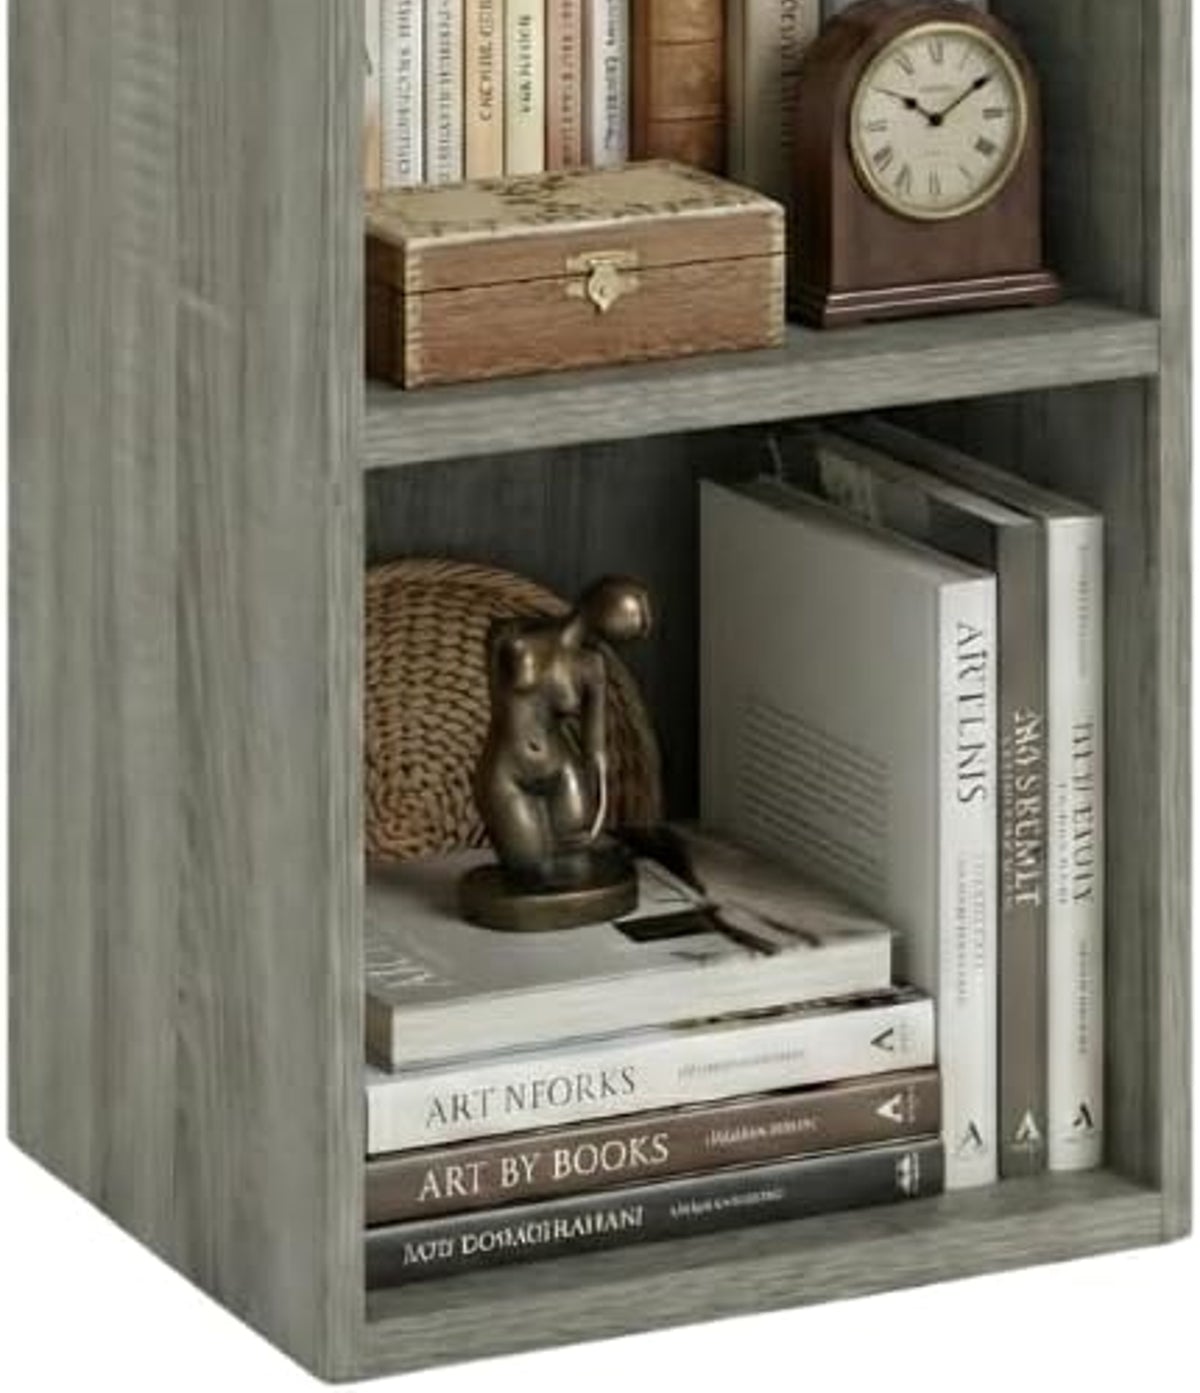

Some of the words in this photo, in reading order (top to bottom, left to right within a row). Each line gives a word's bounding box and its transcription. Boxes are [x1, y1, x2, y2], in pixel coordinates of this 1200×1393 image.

[426, 1086, 495, 1129] ART
[417, 1160, 490, 1202] ART
[501, 1151, 541, 1189] BY
[553, 1132, 670, 1181] BOOKS
